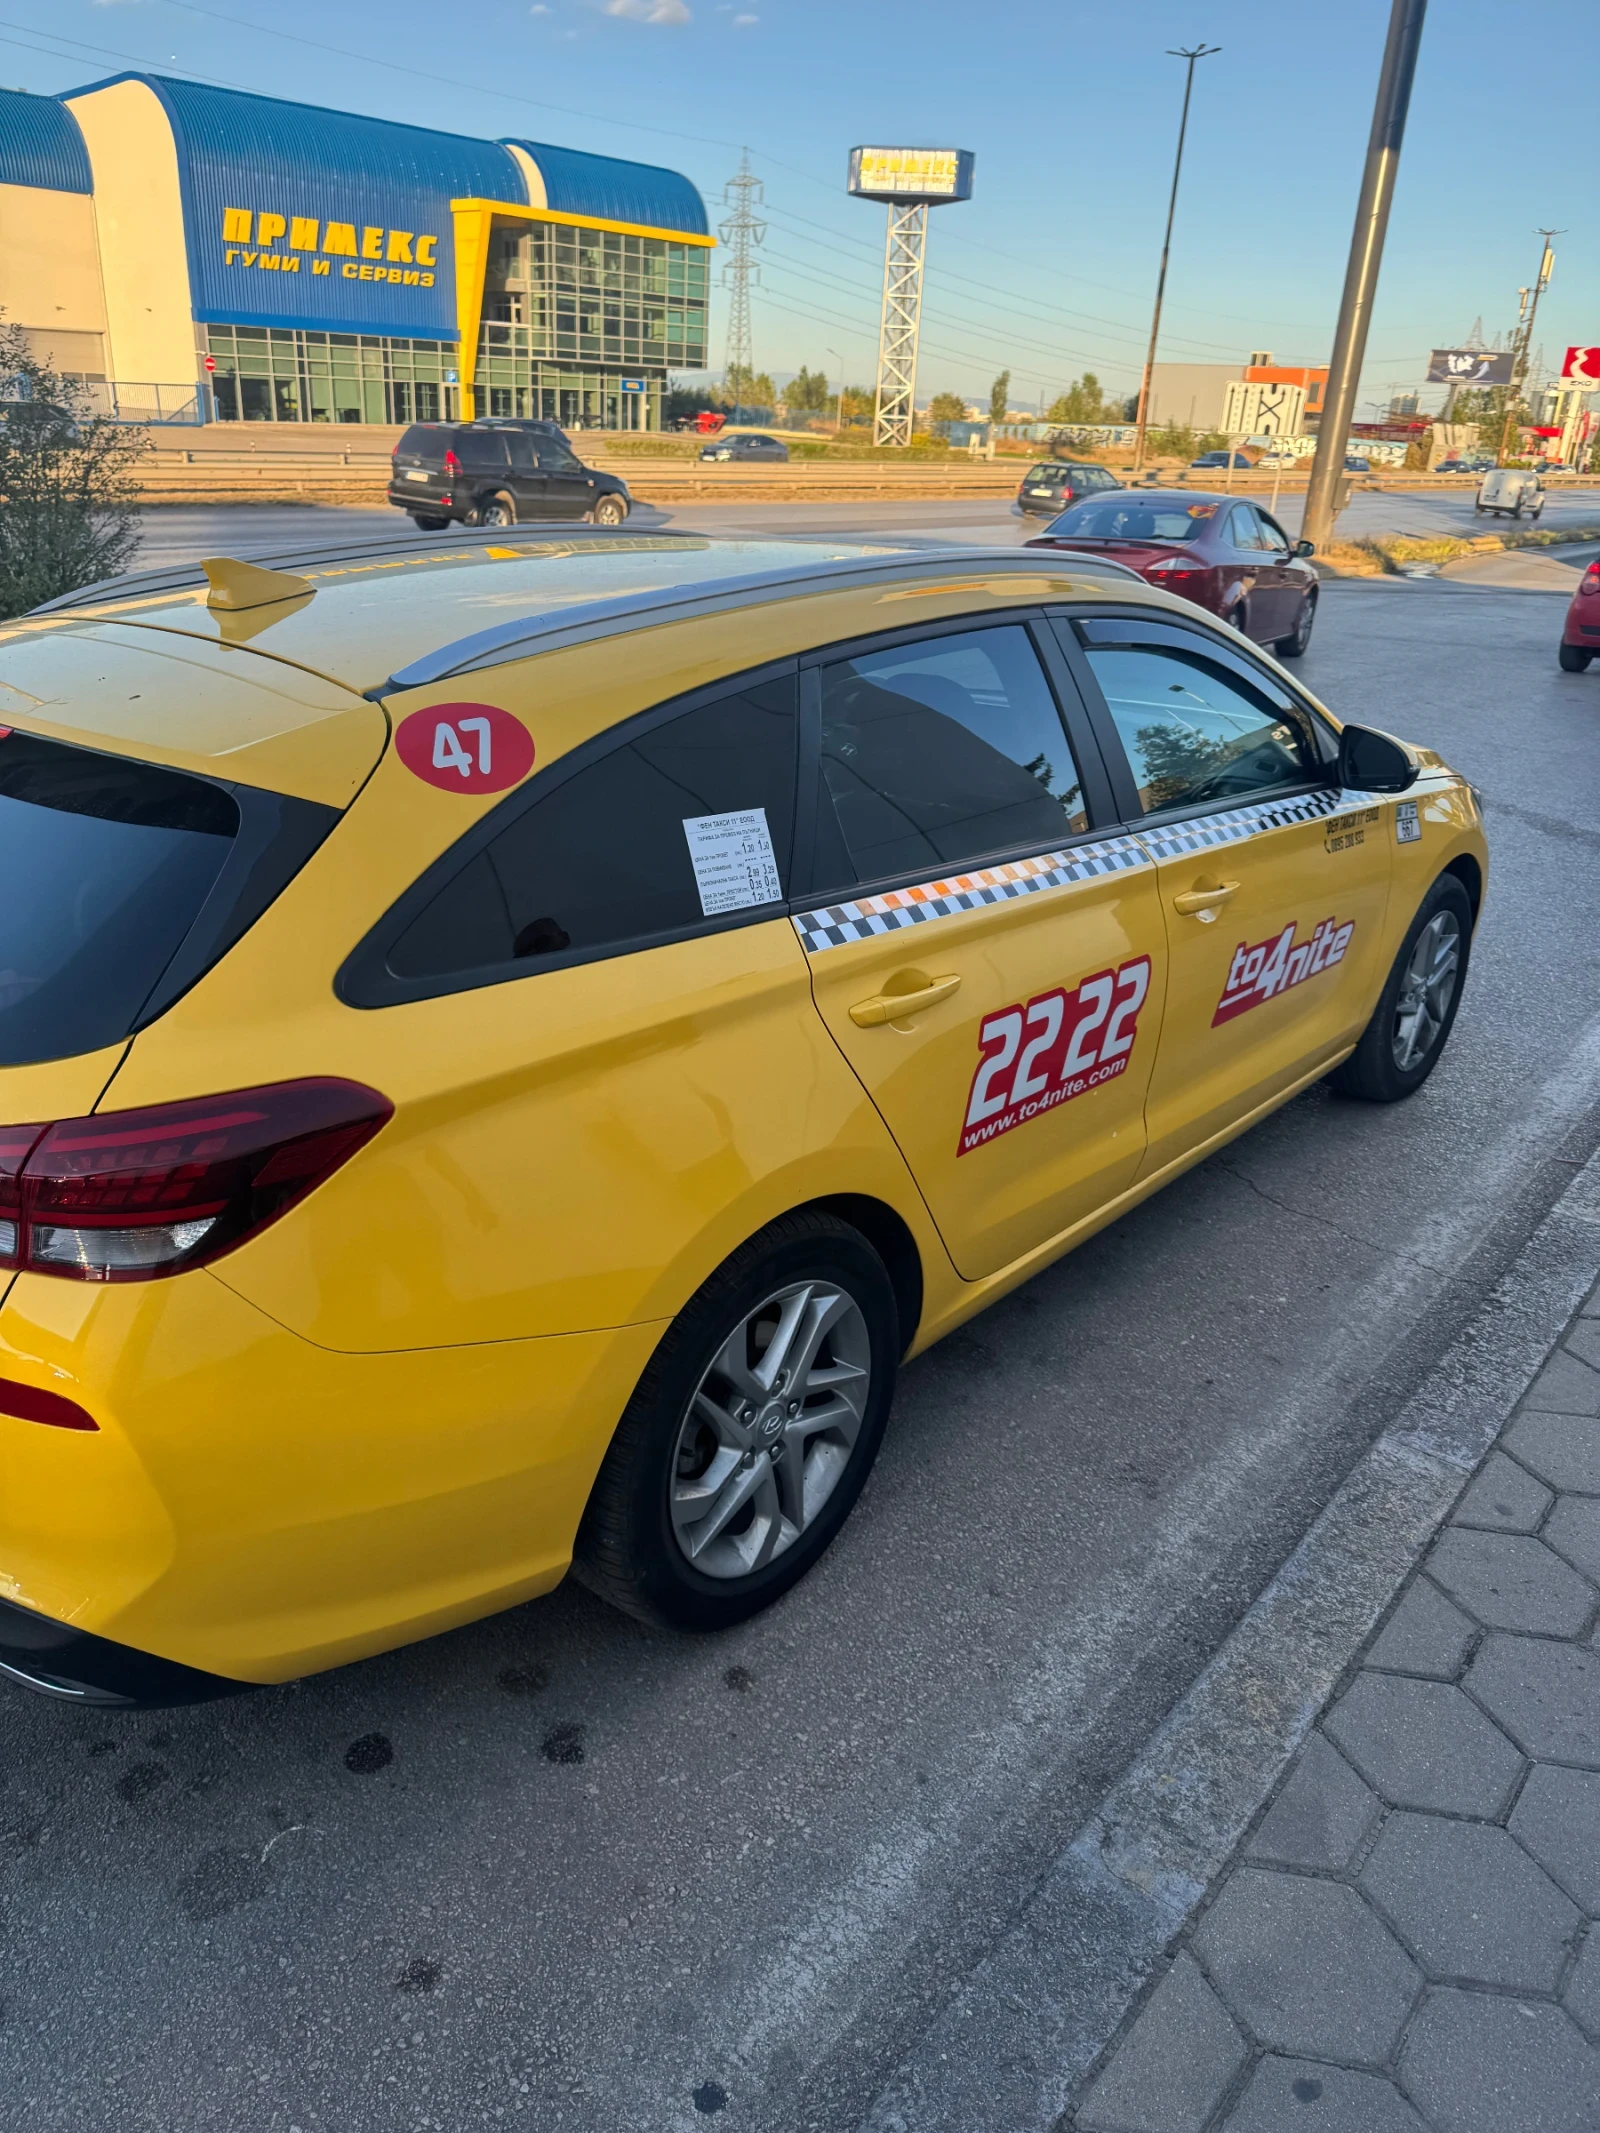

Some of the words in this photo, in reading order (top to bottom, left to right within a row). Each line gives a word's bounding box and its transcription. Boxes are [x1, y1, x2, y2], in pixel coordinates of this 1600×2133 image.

[223, 207, 437, 266] ПРИМЕКС
[225, 249, 301, 273] ГУМИ
[312, 259, 331, 276] И
[342, 263, 435, 287] СЕРВИЗ
[432, 717, 491, 777] 47
[739, 815, 755, 823] ЕООД
[742, 841, 754, 853] 1.20
[749, 877, 762, 890] 0.35
[752, 890, 765, 902] 1.20
[767, 887, 779, 898] 1.50
[1226, 920, 1354, 1000] to4nite
[964, 1058, 1126, 1148] www.to4nite.com
